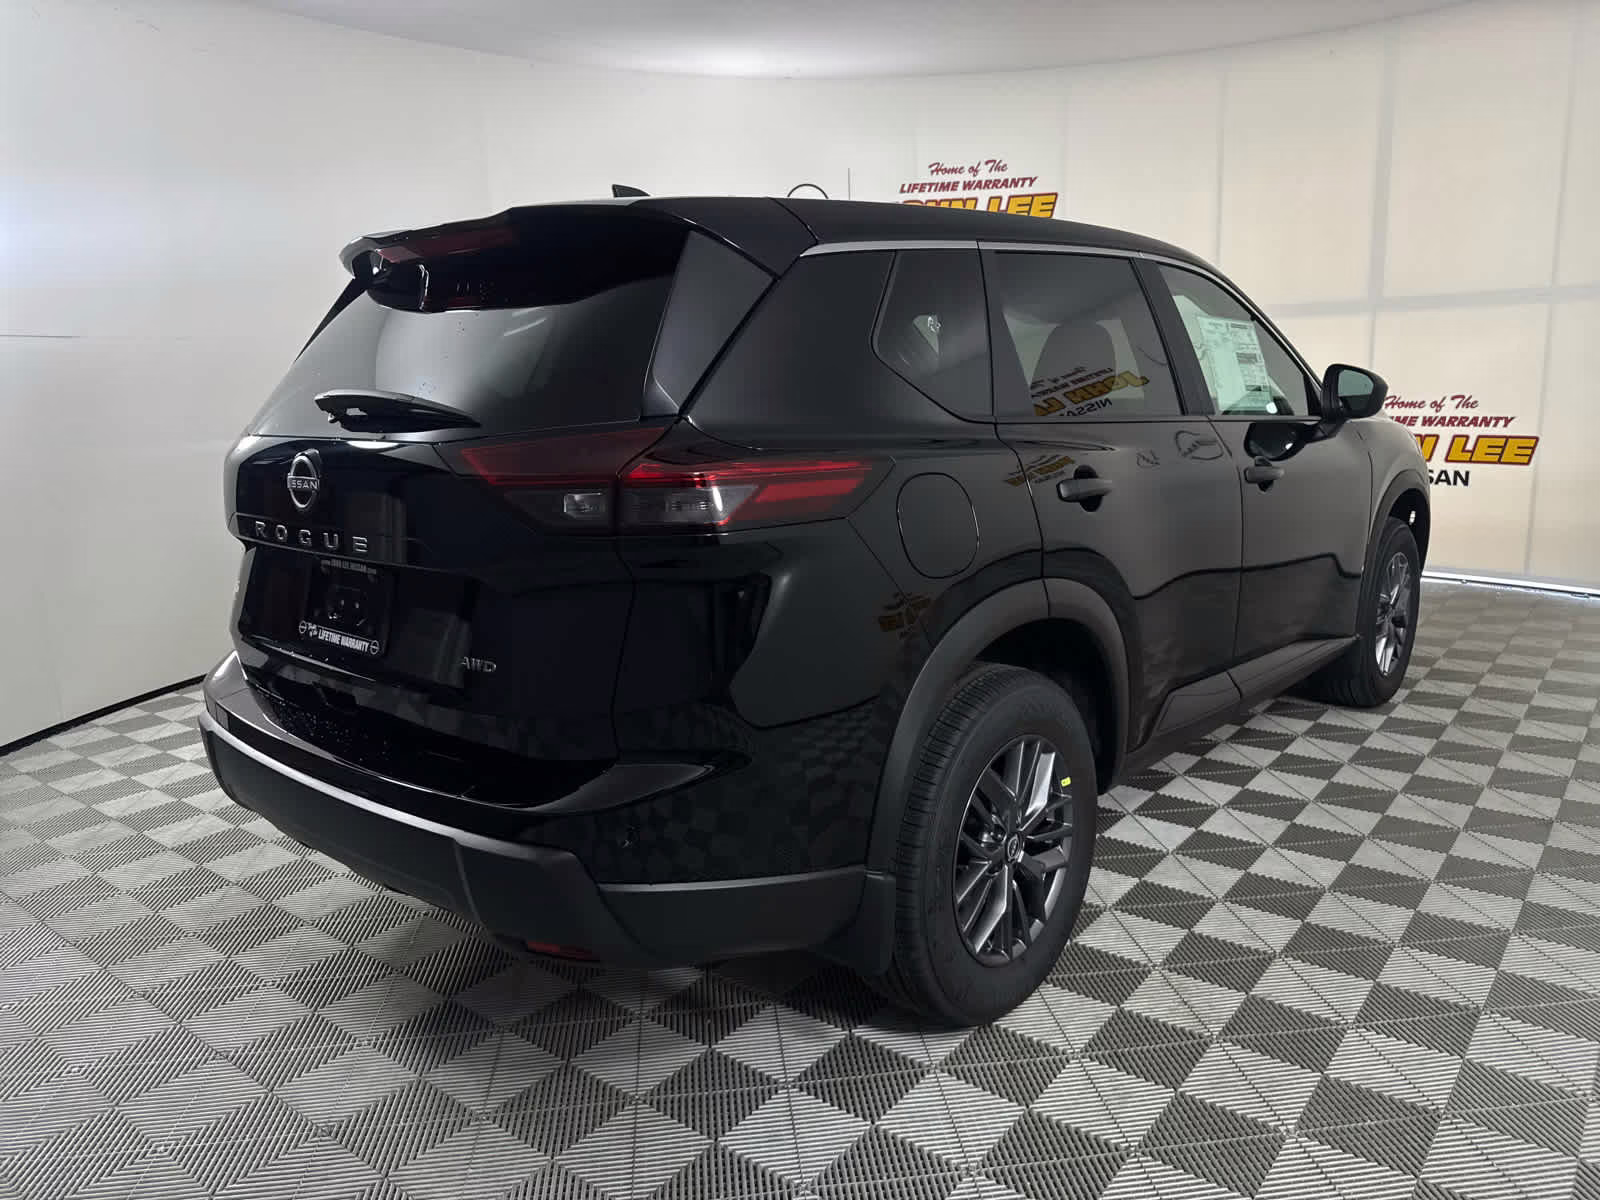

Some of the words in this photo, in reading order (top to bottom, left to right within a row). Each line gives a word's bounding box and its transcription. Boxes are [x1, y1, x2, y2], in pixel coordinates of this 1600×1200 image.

[928, 162, 965, 176] Home
[968, 161, 980, 177] of
[984, 159, 1008, 173] The
[899, 180, 960, 194] LIFETIME
[962, 176, 1038, 191] WARRANTY
[986, 192, 1058, 219] LEE
[1384, 395, 1425, 409] Home
[1430, 396, 1446, 413] of
[1451, 394, 1480, 409] The
[1421, 416, 1515, 428] WARRANTY
[1445, 434, 1539, 465] LEE
[254, 520, 369, 553] ROGUE
[317, 628, 341, 647] LIFETIME
[341, 635, 370, 653] WARRANTY
[460, 656, 497, 673] AWD
